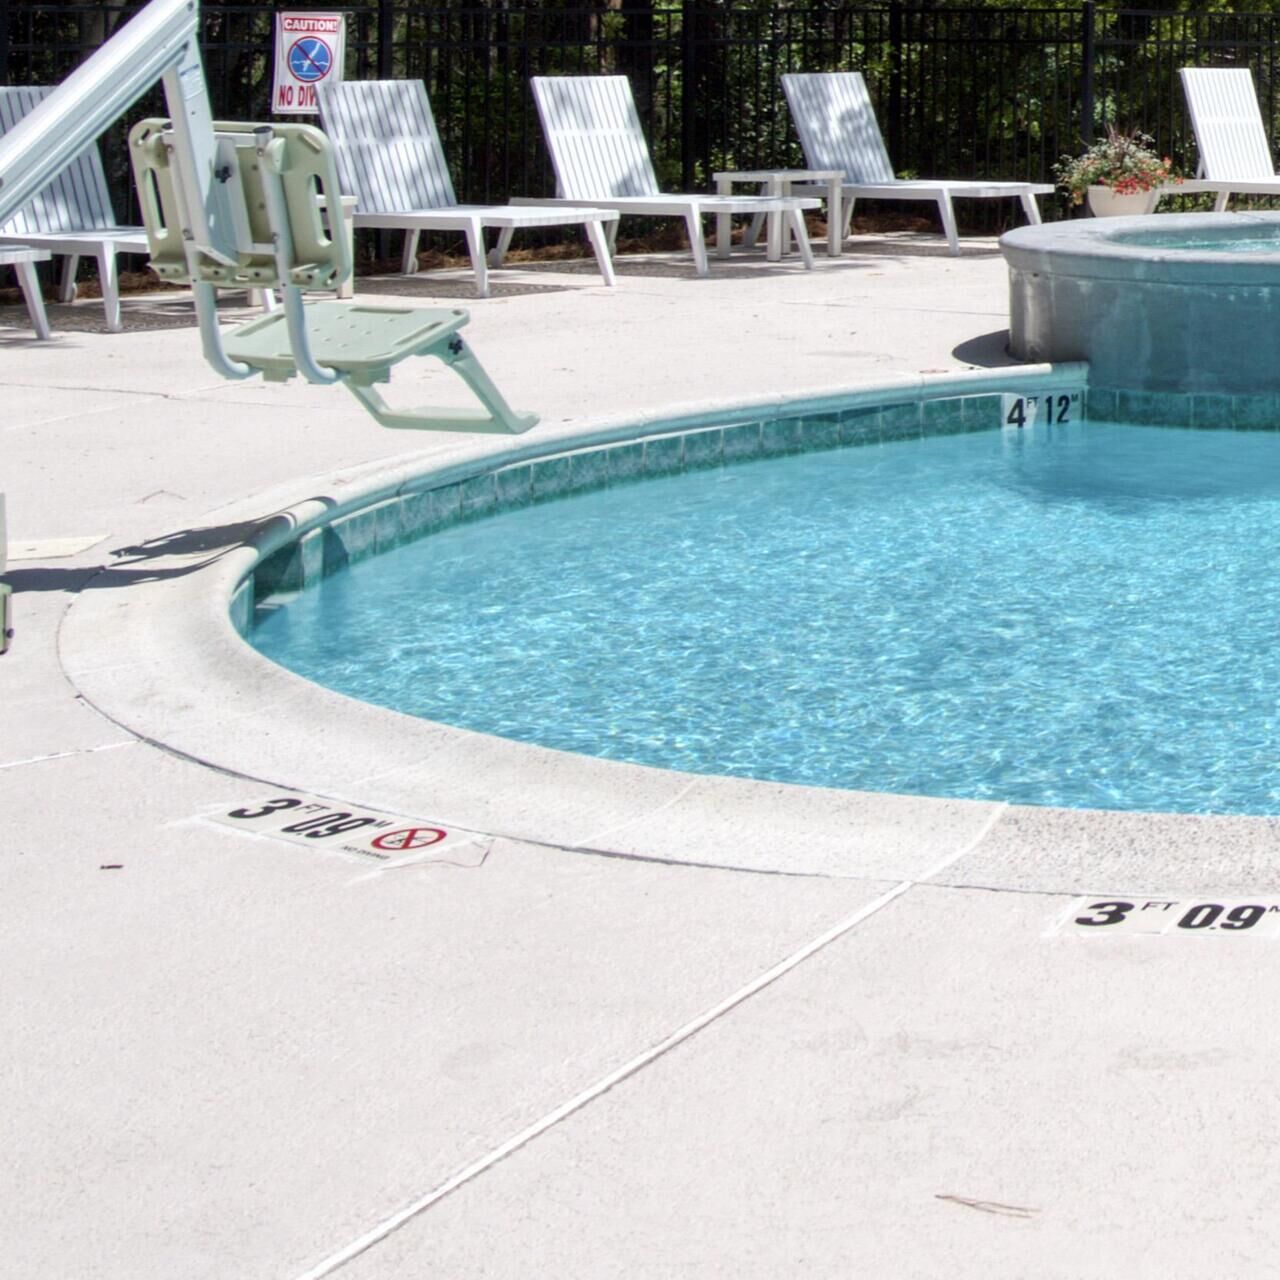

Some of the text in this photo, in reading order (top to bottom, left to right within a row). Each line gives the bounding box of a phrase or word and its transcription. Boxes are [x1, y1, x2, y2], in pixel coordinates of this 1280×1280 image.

[284, 18, 337, 31] CAUTION!
[279, 85, 293, 106] NO
[1007, 398, 1027, 428] 4
[1026, 397, 1039, 408] FT
[228, 798, 302, 819] 3
[293, 803, 332, 814] FT
[1075, 901, 1135, 927] 3
[1141, 901, 1180, 911] FT
